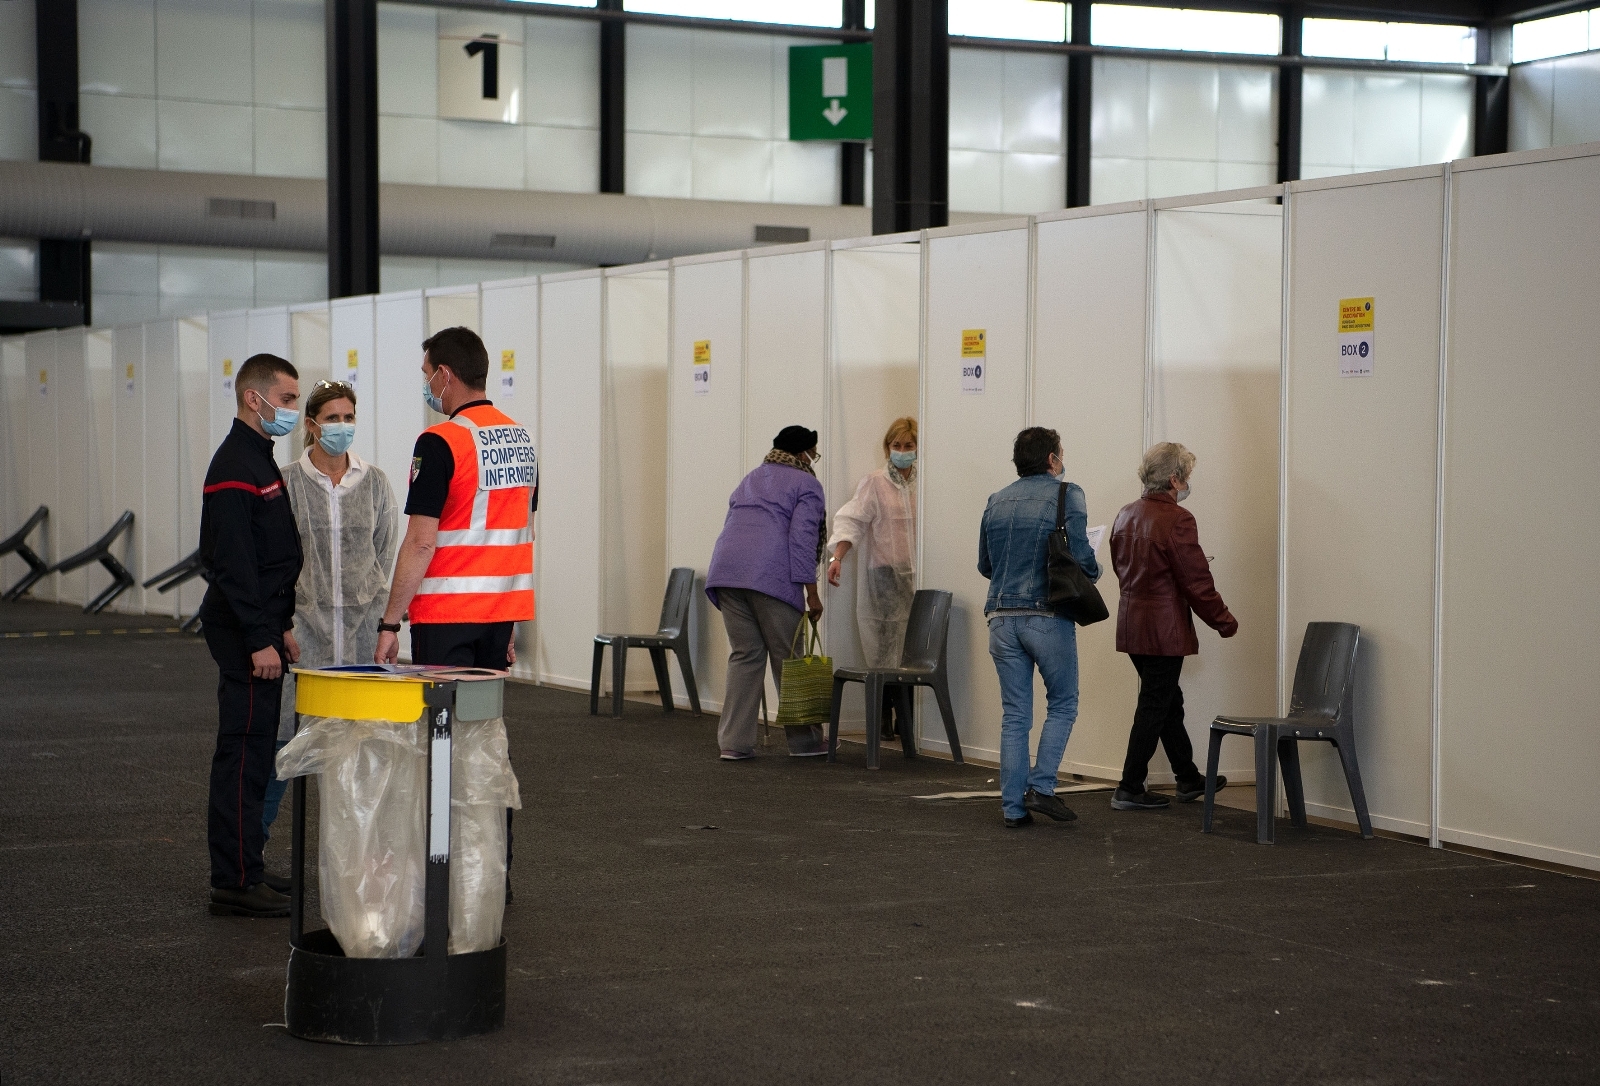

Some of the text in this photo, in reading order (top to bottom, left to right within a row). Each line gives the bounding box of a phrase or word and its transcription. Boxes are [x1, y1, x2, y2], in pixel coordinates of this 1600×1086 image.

[463, 33, 499, 99] 1
[1342, 345, 1358, 356] BOX
[963, 367, 974, 377] BOX
[478, 427, 531, 446] SAPEURS
[481, 446, 536, 466] POMPIERS
